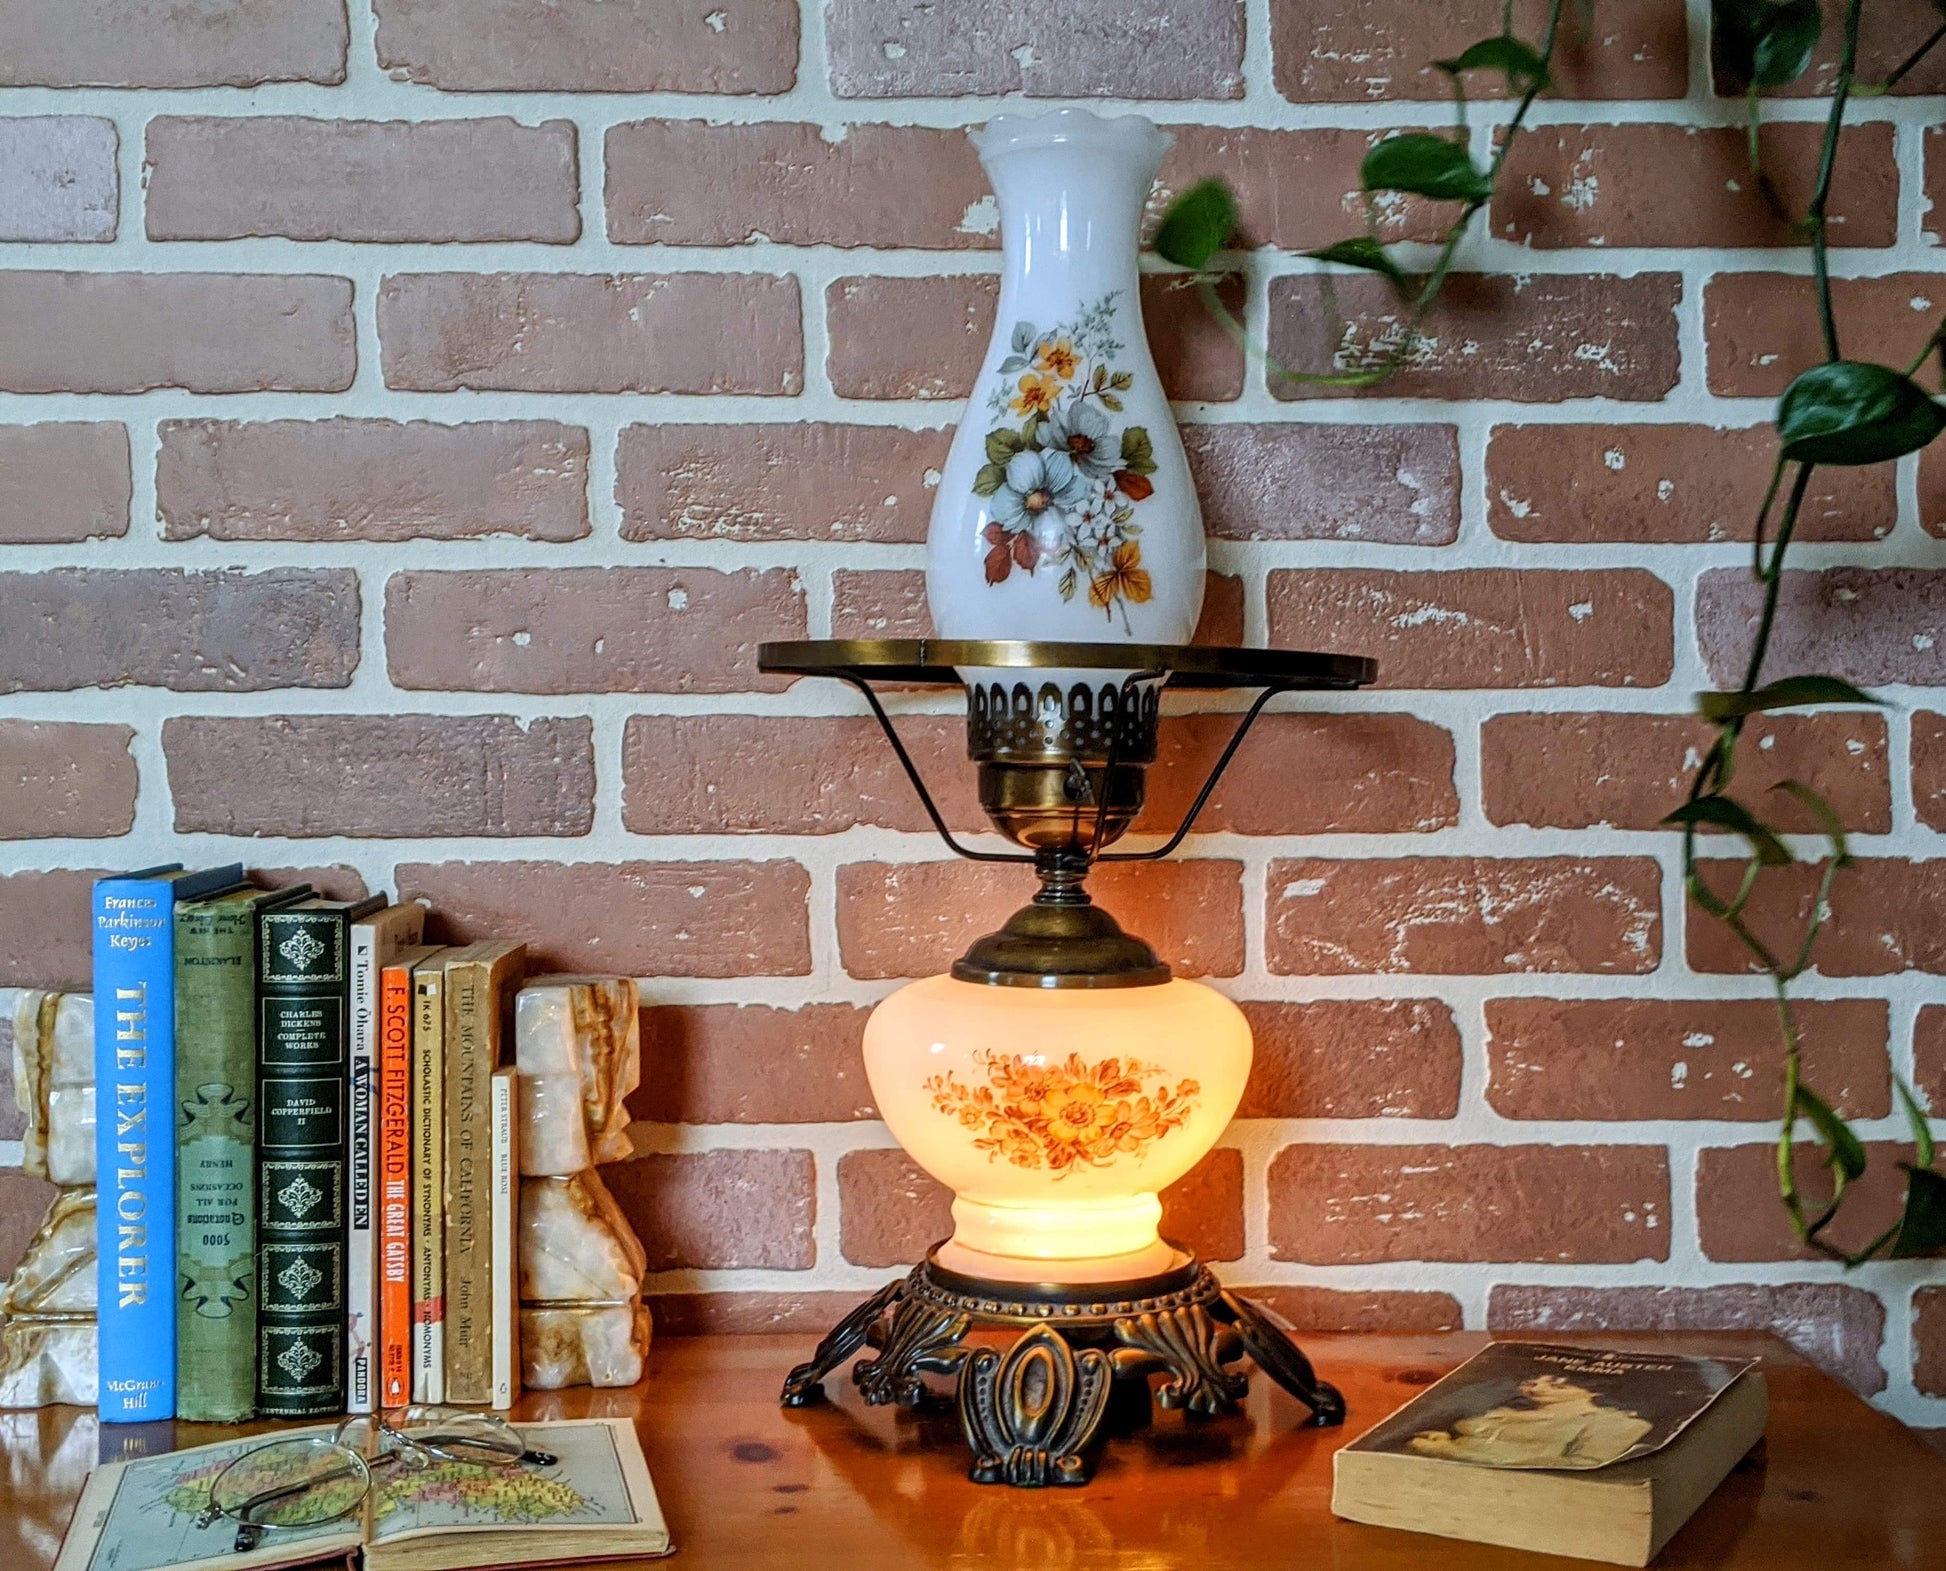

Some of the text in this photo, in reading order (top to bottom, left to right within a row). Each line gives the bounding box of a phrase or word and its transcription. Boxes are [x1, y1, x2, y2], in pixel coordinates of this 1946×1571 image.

[110, 934, 151, 951] Keyes
[356, 960, 371, 1051] Tomie Ōhara
[280, 1011, 322, 1019] CHARLES
[281, 1020, 321, 1028] DICKENS
[423, 1014, 432, 1032] 675
[277, 1032, 326, 1040] COMPLETE
[284, 1041, 319, 1049] WORKS
[387, 987, 406, 1174] F. SCOTT FITZGERALD
[423, 1049, 431, 1104] SCHOLASTIC
[271, 1107, 332, 1116] COPPERFIELD
[286, 1099, 316, 1107] DAVID
[459, 984, 474, 1256] THE MOUNTAINS OF CALIFORNIA
[116, 981, 147, 1310] THE EXPLORER
[355, 1059, 368, 1227] A WOMAN CALLED EN
[423, 1108, 431, 1165] DICTIONARY
[200, 1160, 233, 1168] HENRY
[423, 1168, 431, 1180] OF
[190, 1182, 243, 1191] OCCASIONS
[195, 1198, 238, 1206] FOR ALL
[423, 1183, 431, 1237] SYNONYMS
[202, 1233, 230, 1246] 5000
[386, 1180, 406, 1283] THE GREAT GATSBY
[423, 1247, 432, 1301] ANTONYMS
[459, 1276, 472, 1348] John Muir
[356, 1359, 367, 1402] PANDORA
[123, 1391, 147, 1409] Hill
